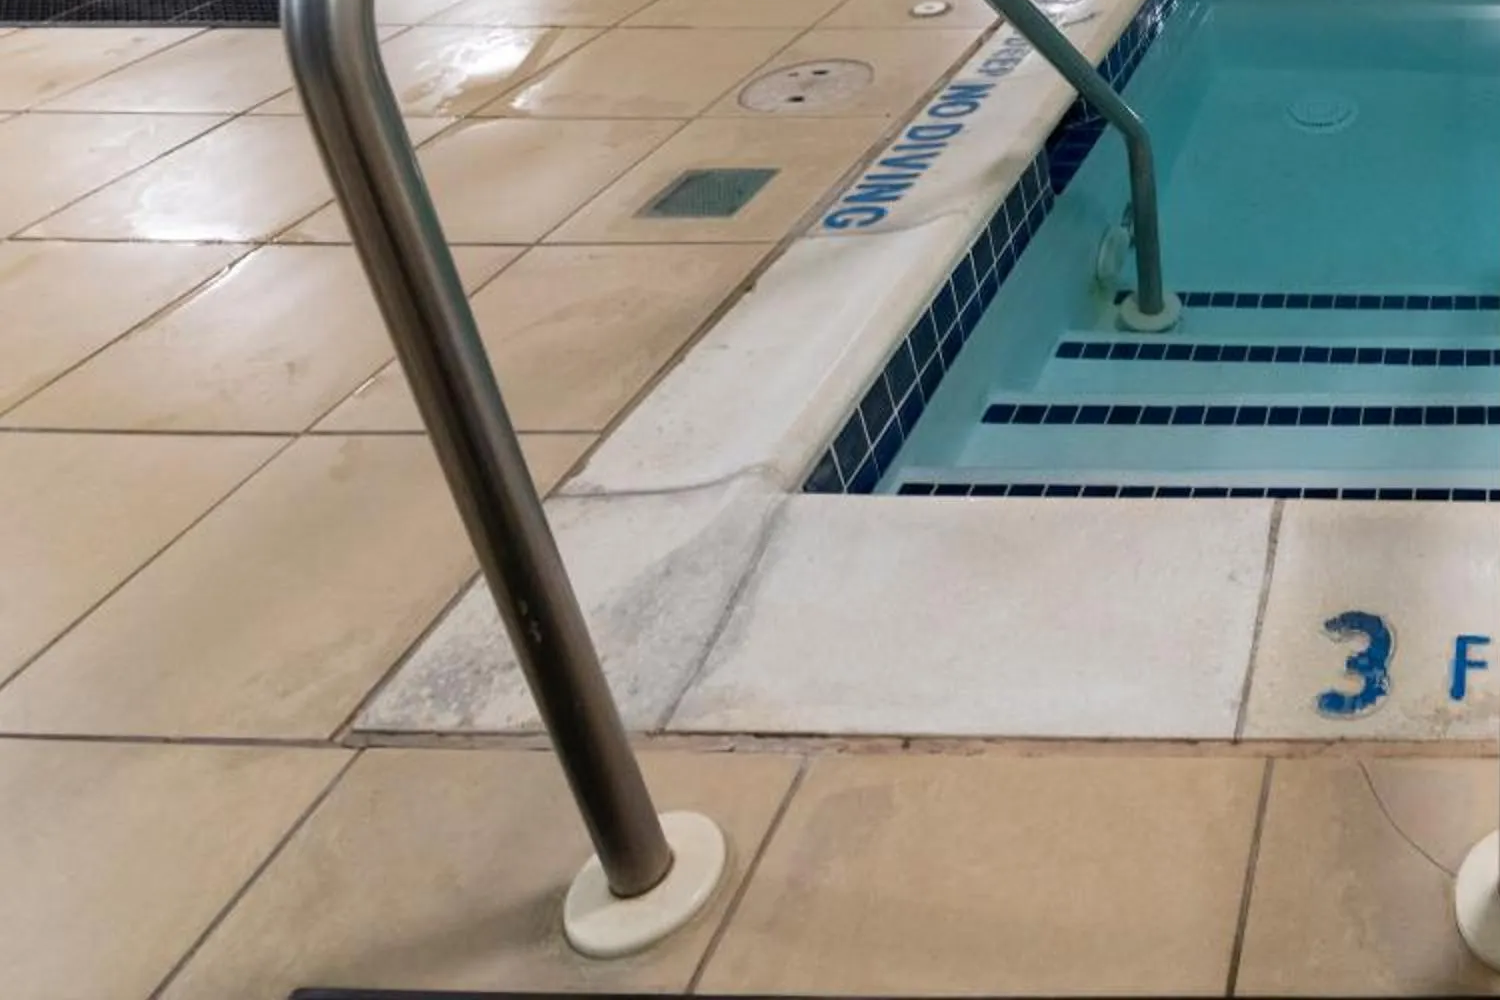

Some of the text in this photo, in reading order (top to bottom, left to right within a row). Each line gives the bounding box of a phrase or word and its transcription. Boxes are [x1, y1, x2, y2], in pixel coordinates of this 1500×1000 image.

[928, 82, 996, 118] NO
[823, 123, 963, 230] DIVING
[1316, 610, 1395, 716] 3
[1447, 634, 1494, 702] F
